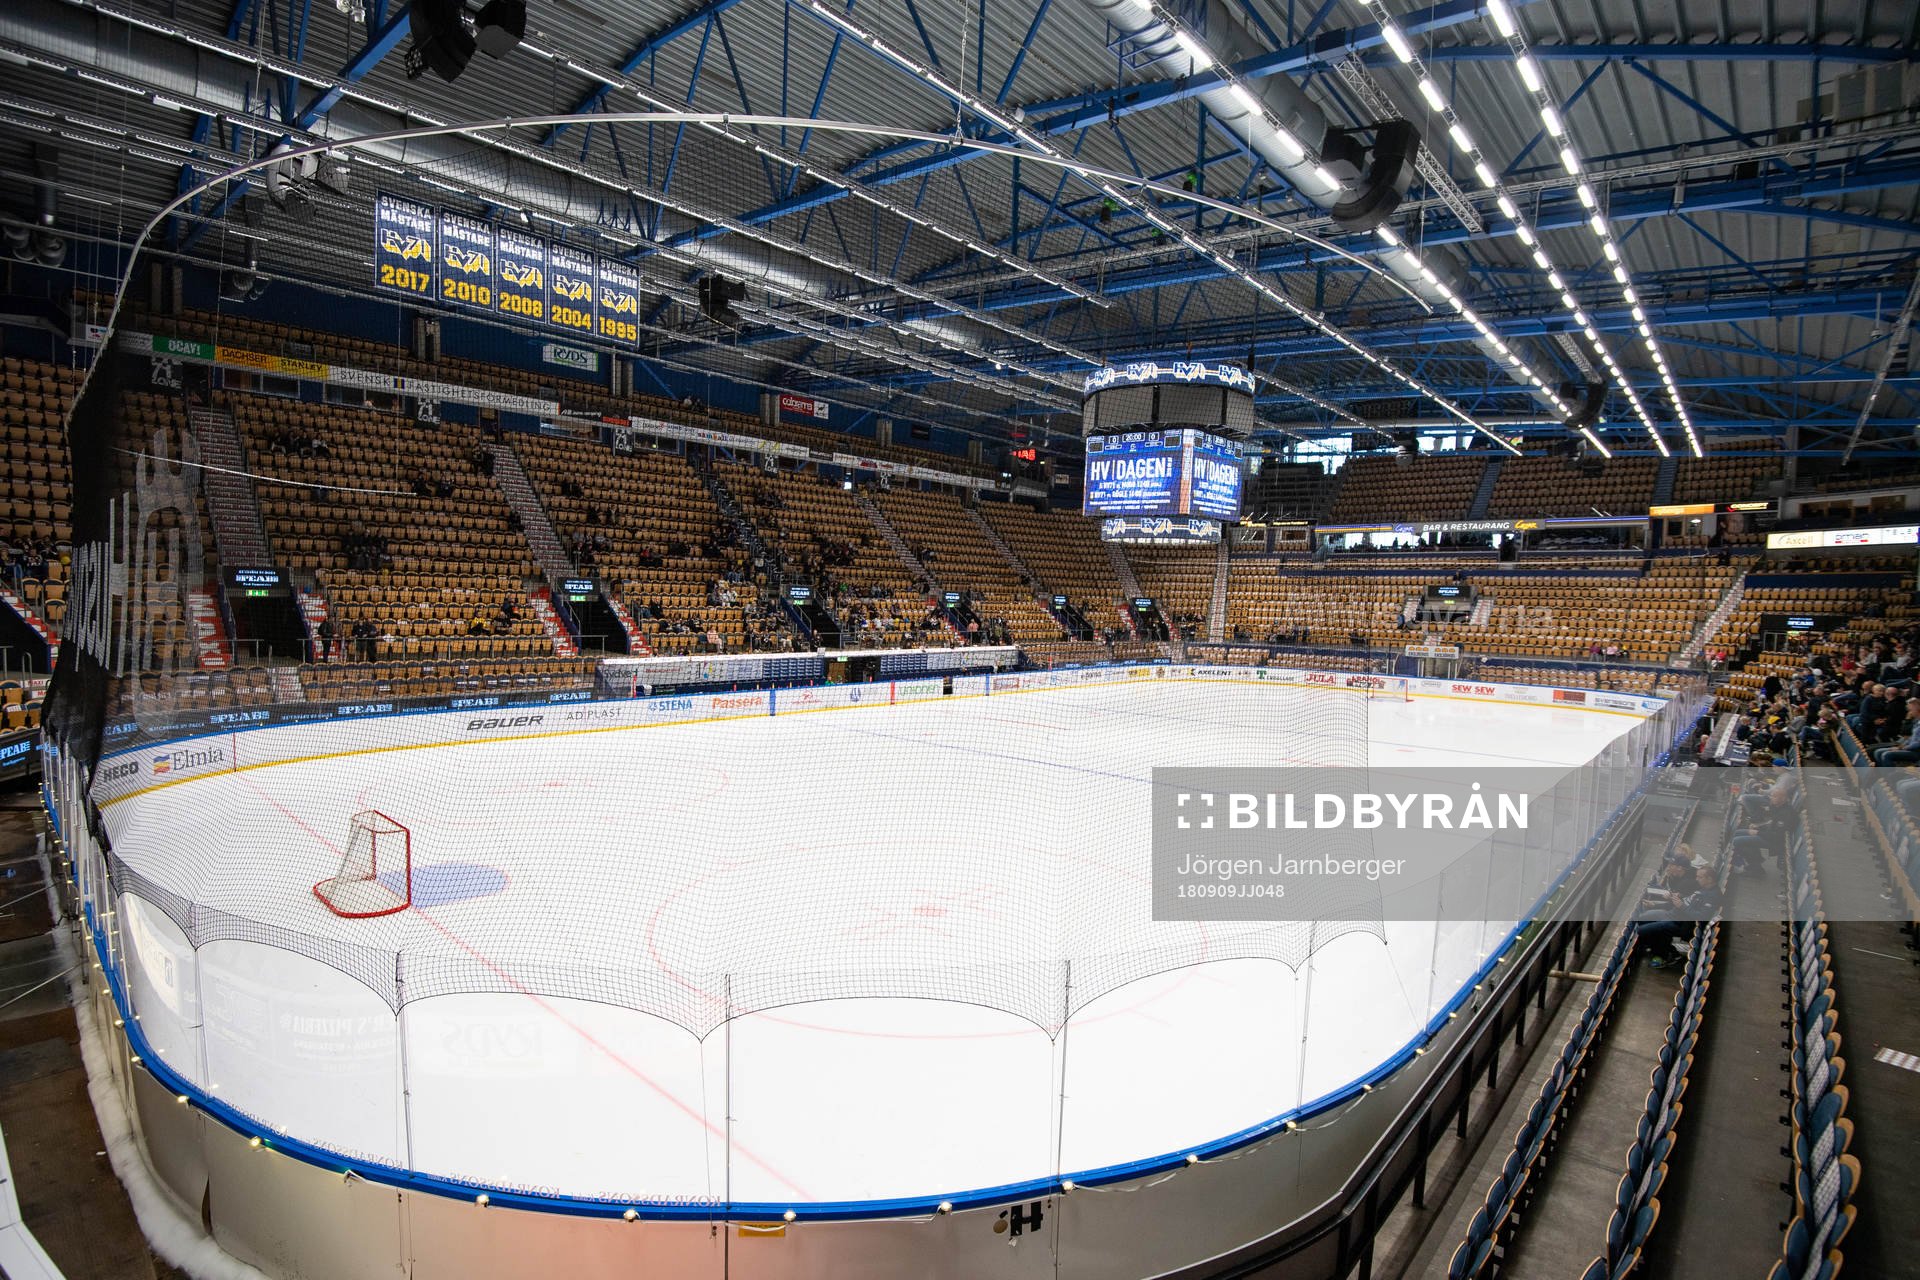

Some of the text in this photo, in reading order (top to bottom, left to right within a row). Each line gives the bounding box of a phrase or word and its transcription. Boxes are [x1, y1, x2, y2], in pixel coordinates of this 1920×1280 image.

[381, 196, 431, 219] SVENSKA
[381, 208, 431, 232] MÄSTARE
[444, 212, 490, 234] SVENSKA
[443, 224, 490, 246] MÄSTARE
[500, 229, 543, 249] SVENSKA
[500, 241, 543, 262] MÄSTARE
[552, 244, 592, 265] SVENSKA
[552, 255, 592, 276] MÄSTARE
[600, 259, 637, 277] SVENSKA
[381, 264, 430, 292] 2017
[600, 269, 637, 289] MÄSTARE
[443, 278, 491, 305] 2010
[500, 292, 543, 318] 2008
[551, 305, 592, 330] 2004
[600, 316, 637, 340] 1995
[222, 348, 267, 363] DACHSER
[280, 358, 323, 372] STANLEY
[553, 347, 588, 363] RYDS
[340, 370, 390, 386] SVENSK
[1091, 457, 1167, 480] HV DAGEN
[1194, 458, 1237, 486] HV DAGEN
[1450, 522, 1510, 530] RESTAURANG
[1305, 674, 1335, 684] JULA
[1452, 684, 1495, 694] SEW SEW
[452, 698, 499, 708] PEAB
[550, 692, 591, 701] PEAB
[659, 699, 692, 711] STENA
[712, 696, 763, 710] Passera
[210, 711, 270, 725] PEAB
[338, 704, 393, 715] PEAB
[567, 707, 622, 720] AD PLAST
[172, 747, 224, 771] Elmia
